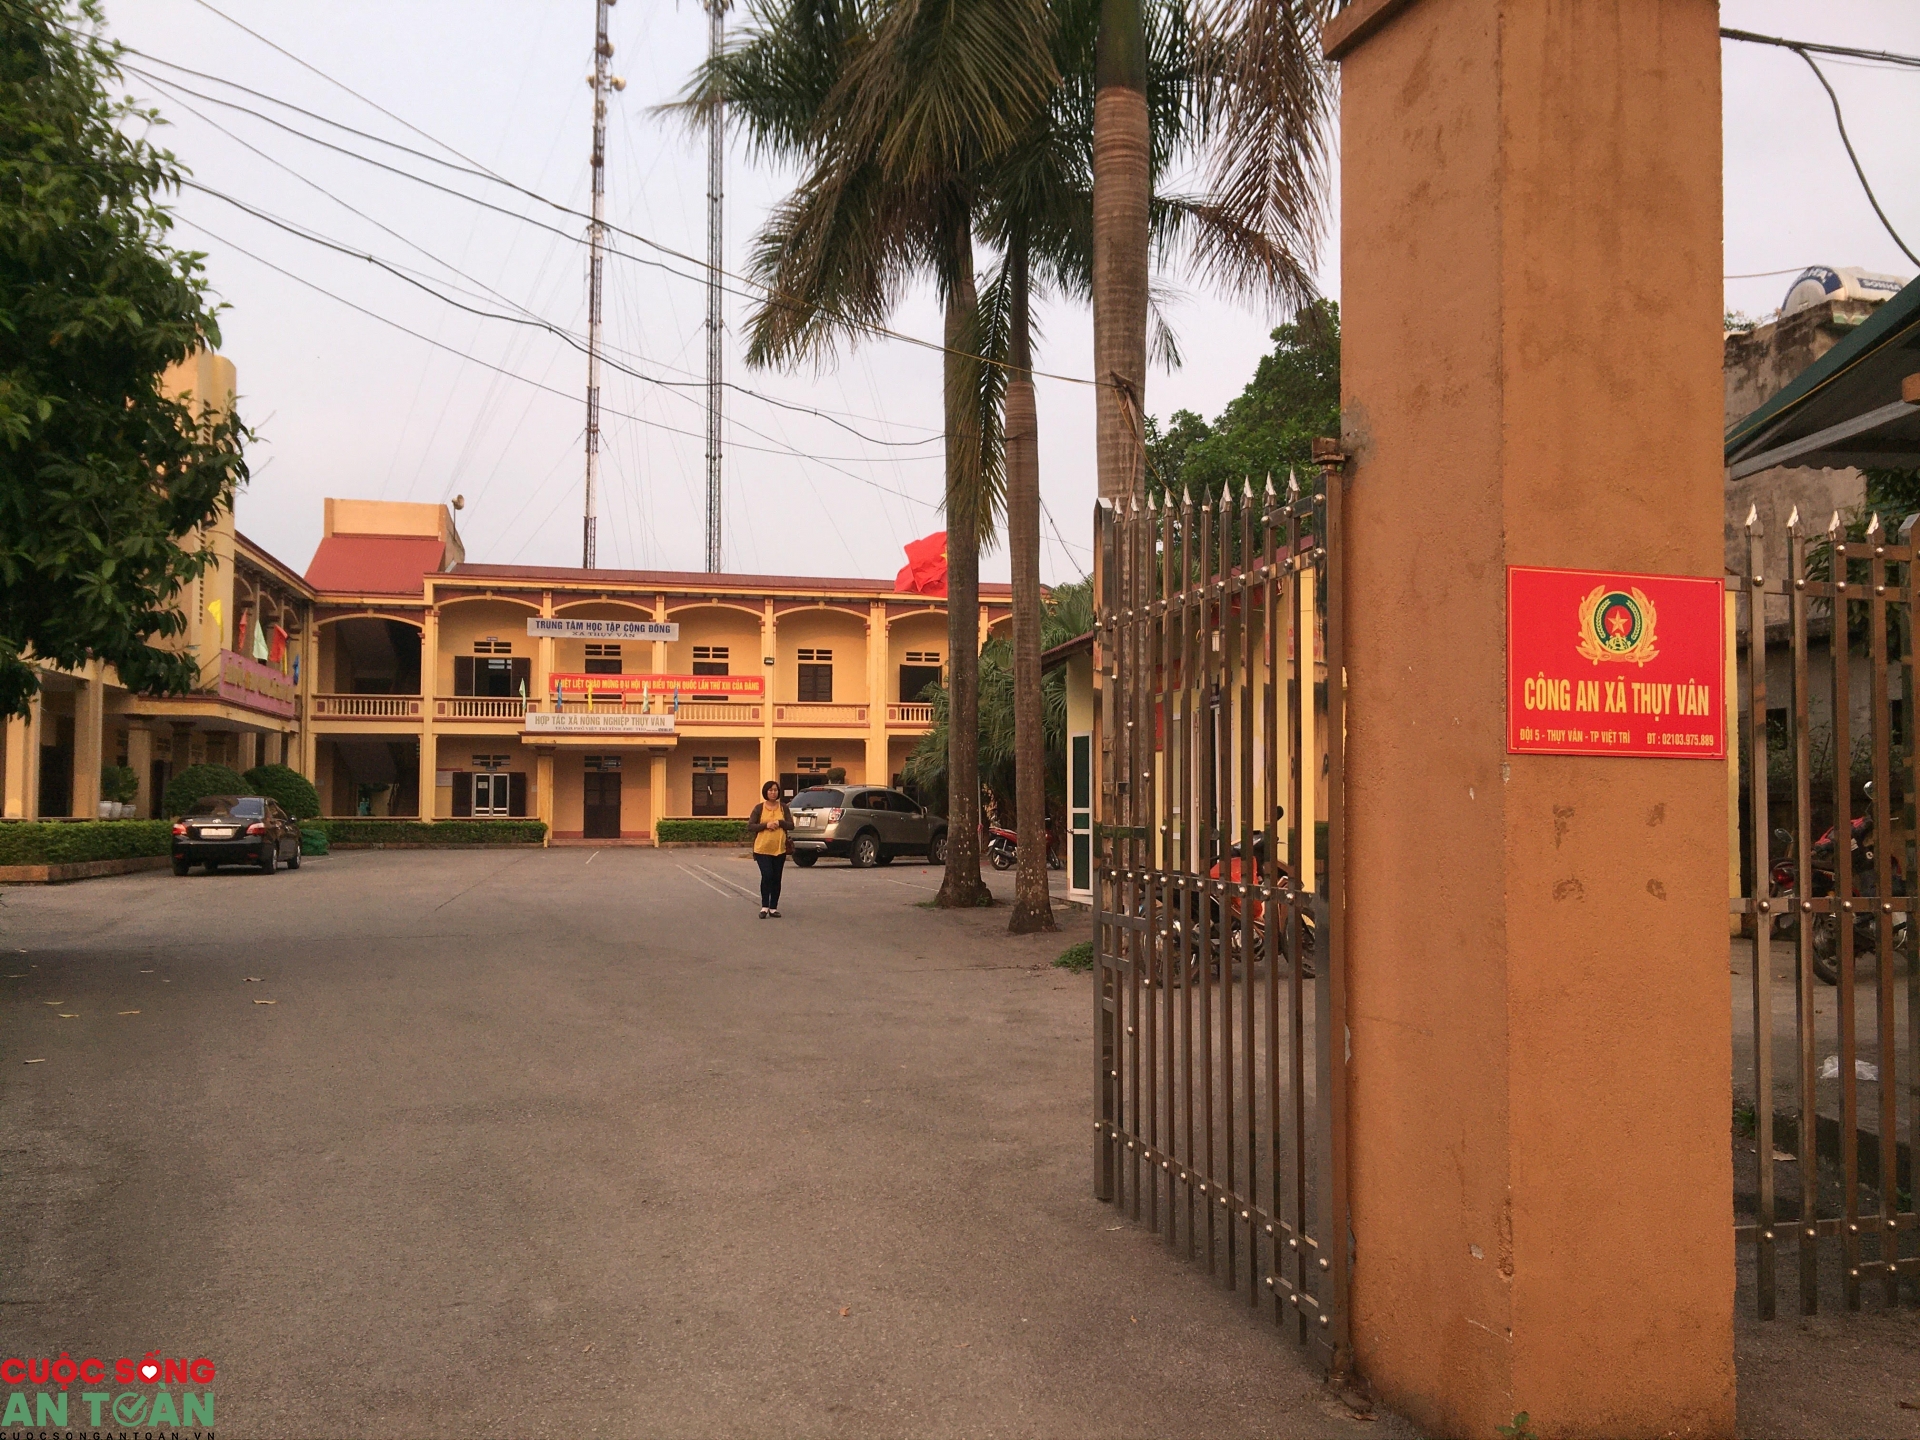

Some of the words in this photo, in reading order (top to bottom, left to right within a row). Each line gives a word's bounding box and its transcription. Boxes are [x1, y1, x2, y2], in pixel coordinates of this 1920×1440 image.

[536, 620, 563, 630] TRUNG
[566, 620, 583, 631] TÂM
[586, 622, 602, 632] HỌC
[606, 621, 620, 632] TẬP
[624, 622, 646, 633] CỘNG
[648, 622, 671, 633] ĐỒNG
[573, 678, 584, 690] LIỆT
[631, 678, 641, 690] HỘI
[666, 679, 681, 690] TOÀN
[682, 679, 697, 690] QUỐC
[732, 680, 743, 690] CỦA
[744, 680, 759, 691] ĐẢNG
[1524, 671, 1571, 711] CÔNG
[1576, 680, 1599, 712] AN
[1604, 676, 1627, 713] XÃ
[1631, 682, 1672, 721] THỤY
[1677, 678, 1709, 716] VÂN
[535, 715, 550, 726] HỢP
[552, 714, 566, 725] TÁC
[568, 715, 578, 725] XÃ
[580, 715, 600, 726] NÔNG
[603, 715, 630, 727] NGHIỆP
[631, 717, 649, 727] THỤY
[651, 716, 665, 726] VÂN
[1520, 726, 1533, 743] ĐỘI
[1534, 729, 1540, 741] 5
[1547, 729, 1566, 744] THỤY
[1567, 727, 1583, 742] VÂN
[1590, 731, 1599, 743] TP
[1601, 729, 1617, 745] VIỆT
[1618, 729, 1630, 744] TRÌ
[1647, 732, 1656, 744] ĐT
[1662, 733, 1714, 746] 02103.975.889
